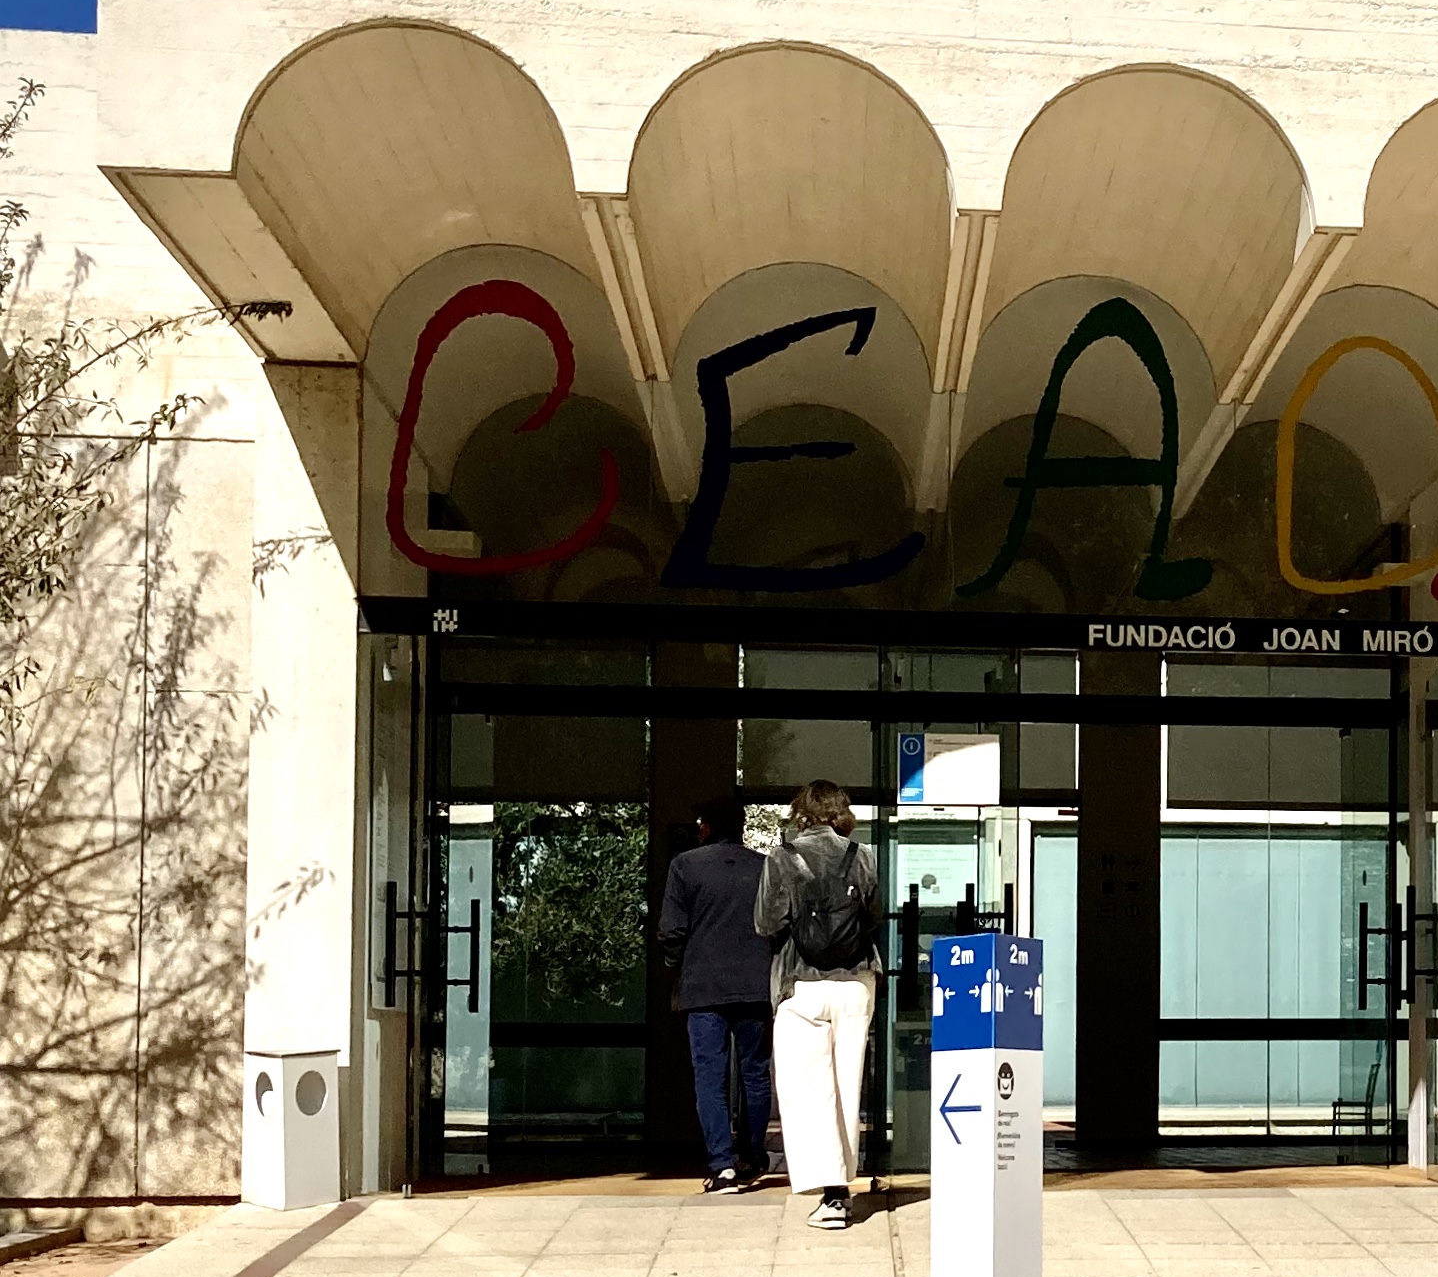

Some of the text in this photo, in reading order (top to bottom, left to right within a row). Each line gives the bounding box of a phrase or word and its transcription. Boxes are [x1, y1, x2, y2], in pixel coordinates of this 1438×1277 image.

[1088, 622, 1434, 653] FUNDACIÓ JOAN MIRÓ
[950, 945, 975, 966] 2m
[1009, 943, 1029, 966] 2m
